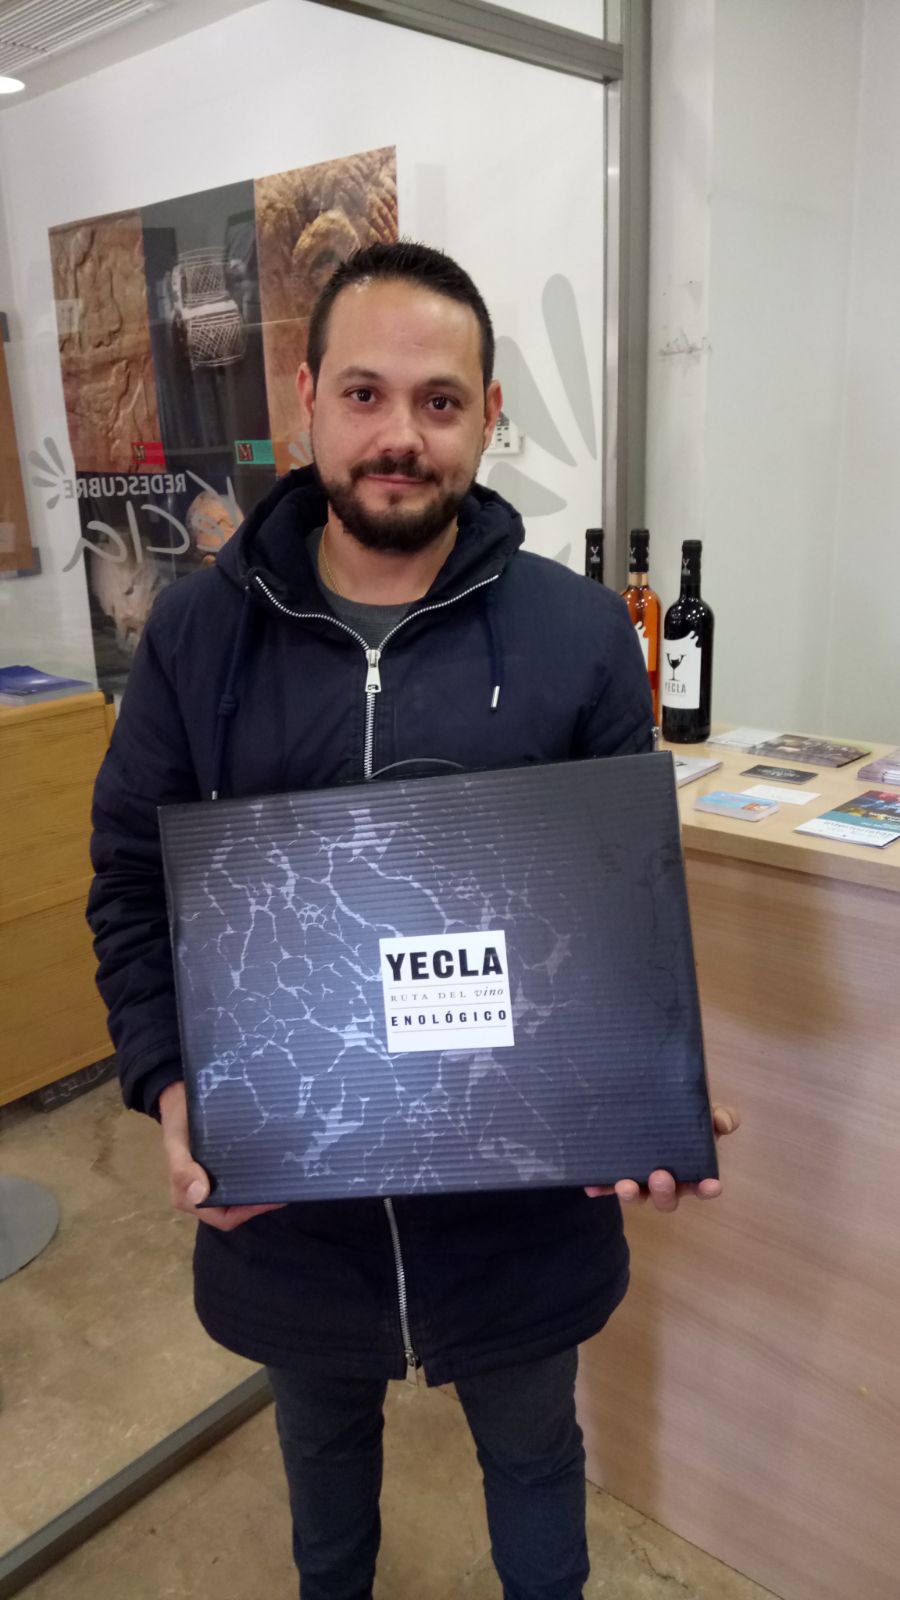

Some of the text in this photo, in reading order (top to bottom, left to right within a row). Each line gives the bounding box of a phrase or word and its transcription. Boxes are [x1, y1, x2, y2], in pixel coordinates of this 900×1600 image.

[665, 681, 687, 694] YECLA
[385, 947, 504, 981] YECLA
[390, 986, 504, 1002] RUTA DEL vino
[391, 1010, 507, 1026] ENOLÓGICO
